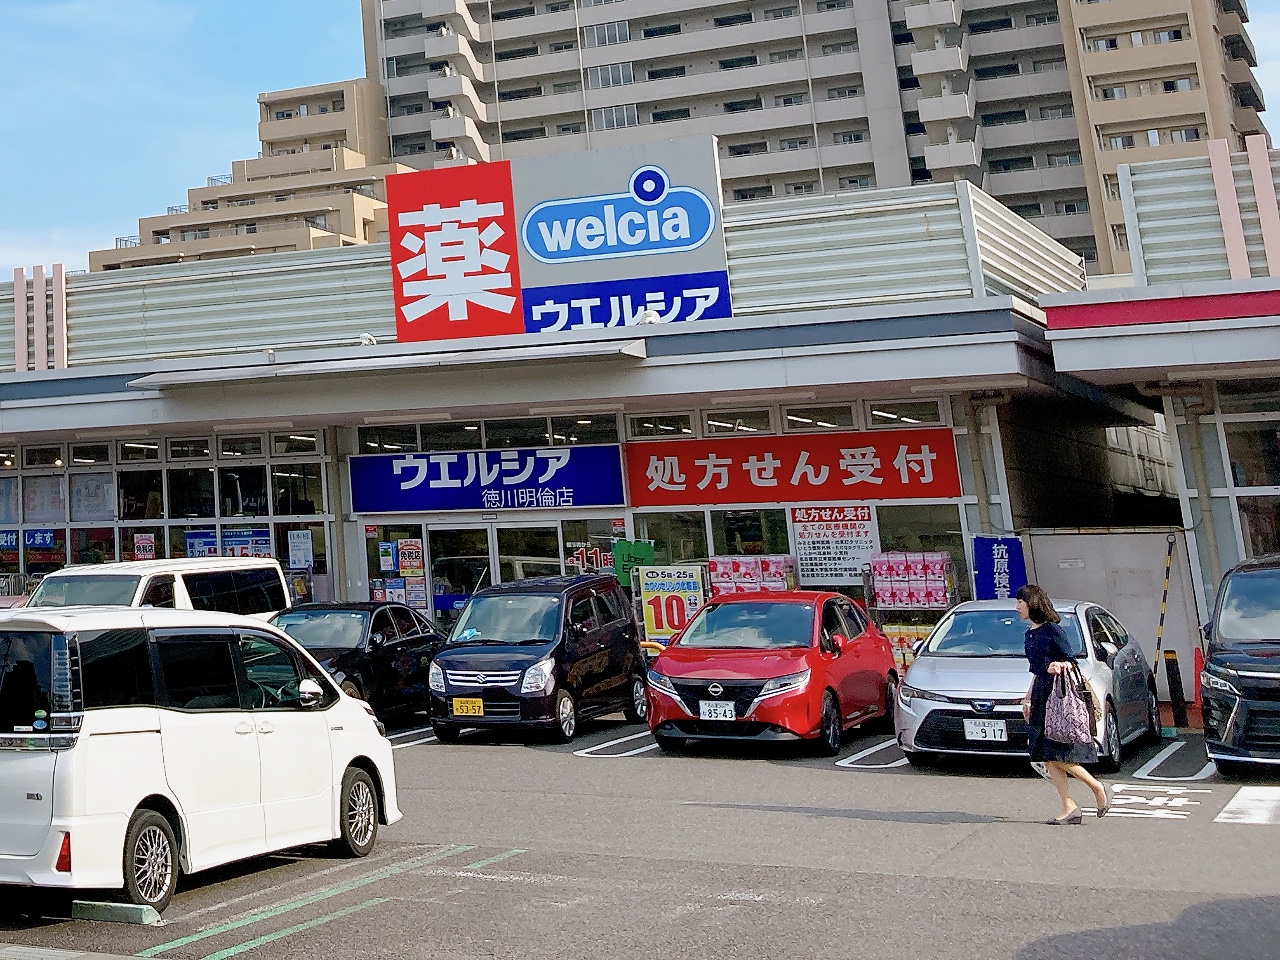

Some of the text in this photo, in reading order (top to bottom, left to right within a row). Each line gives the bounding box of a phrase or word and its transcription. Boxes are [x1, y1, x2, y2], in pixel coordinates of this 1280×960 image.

[537, 179, 690, 252] welcia
[397, 199, 516, 322] 薬
[531, 286, 720, 333] ウエルシア
[393, 448, 570, 490] ウエルシア
[646, 444, 937, 492] 処方せん受付
[482, 487, 574, 508] 徳川明倫店
[795, 507, 869, 521] 処方せん受付
[622, 554, 645, 565] Uber
[647, 595, 686, 630] 10
[460, 705, 481, 715] 53-57
[707, 709, 734, 719] 85-43
